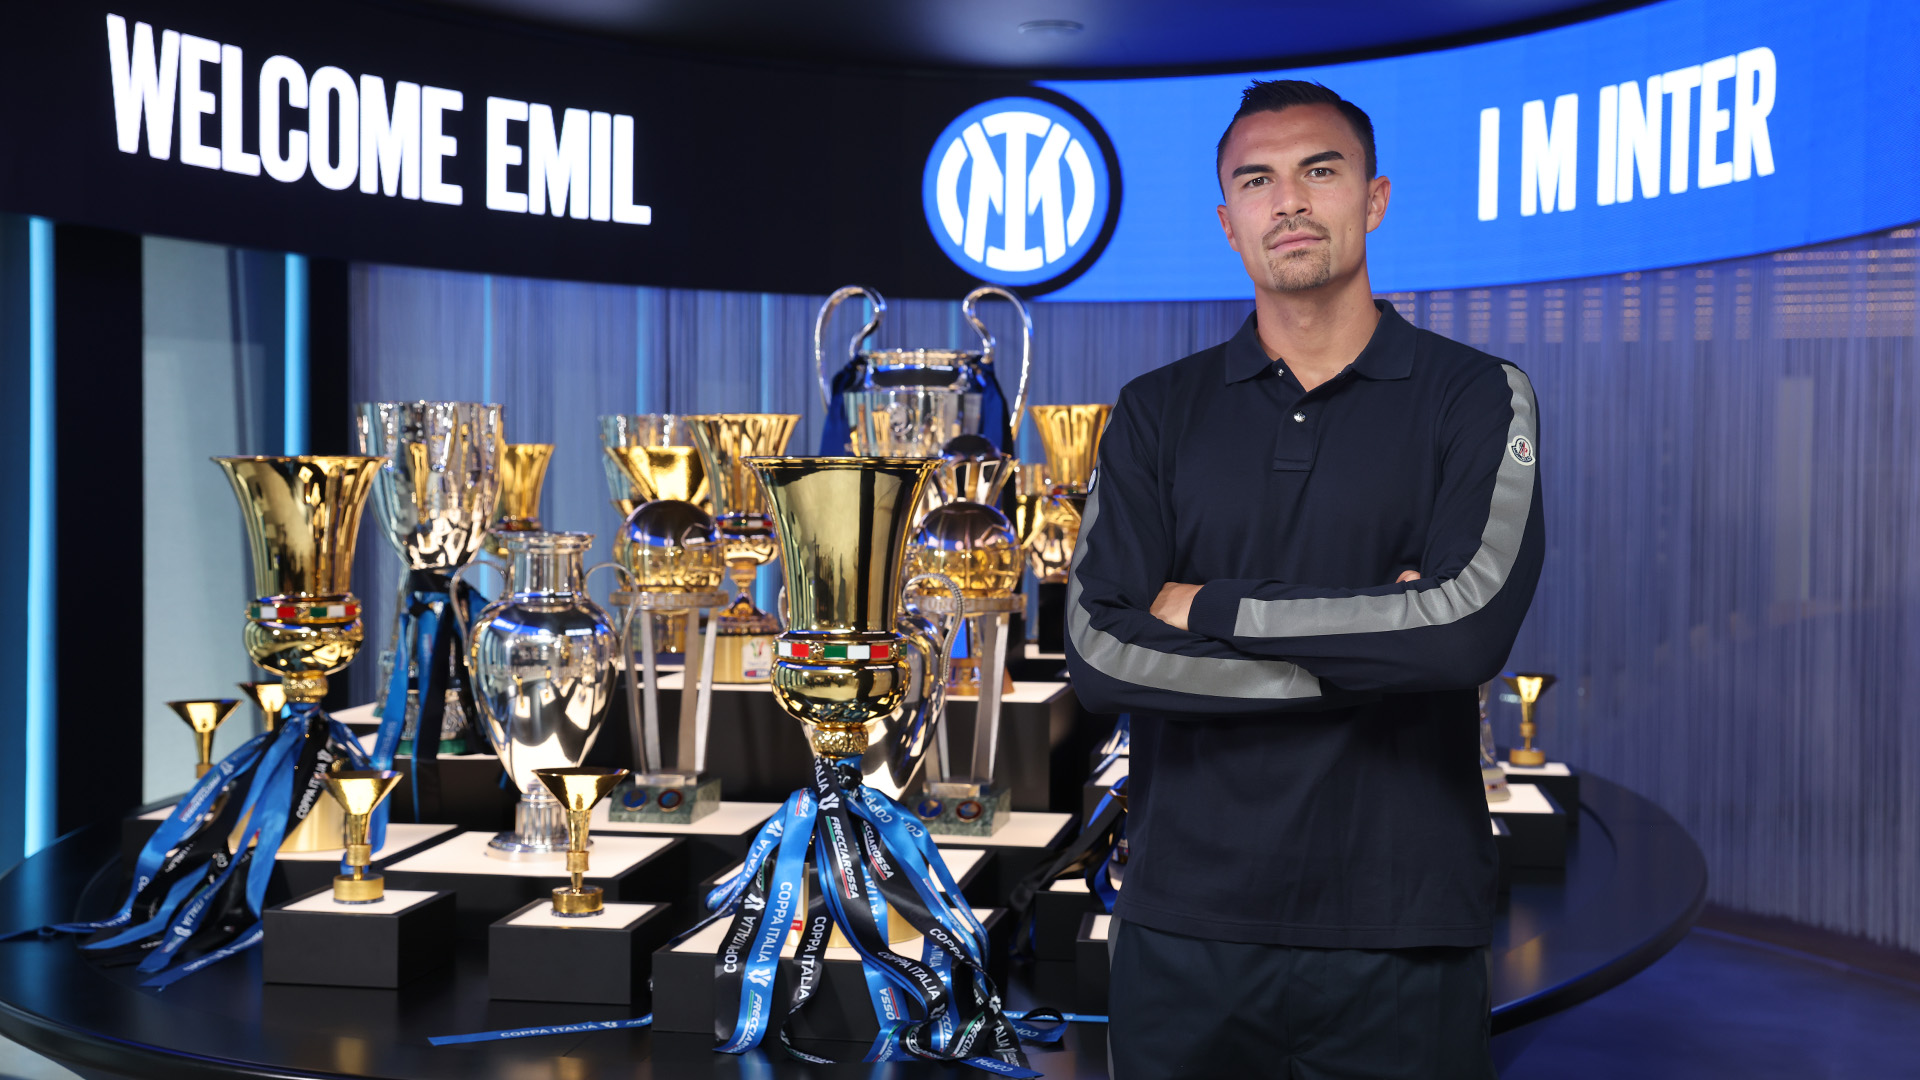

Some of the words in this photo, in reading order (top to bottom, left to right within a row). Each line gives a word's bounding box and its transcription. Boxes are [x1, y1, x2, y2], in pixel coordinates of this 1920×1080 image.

[106, 13, 463, 206] WELCOME
[486, 96, 652, 225] EMIL
[1477, 107, 1500, 221] I
[1520, 93, 1578, 217] M
[1596, 46, 1777, 206] INTER
[814, 755, 829, 793] TALIA
[296, 788, 318, 820] COPPA
[862, 786, 893, 824] COPPA
[745, 839, 771, 878] ITALIA
[830, 816, 860, 899] FRECCIAROSSA
[771, 882, 793, 925] COPPA
[756, 927, 781, 963] ITALIA
[804, 916, 826, 952] COPPA
[929, 928, 965, 961] COPPA
[799, 954, 816, 1000] ITALIA
[877, 951, 911, 968] COPPA
[908, 962, 941, 1000] ITALIA
[500, 1028, 550, 1038] COPPA
[552, 1023, 598, 1033] ITALIA
[975, 1057, 1013, 1072] COPPA
